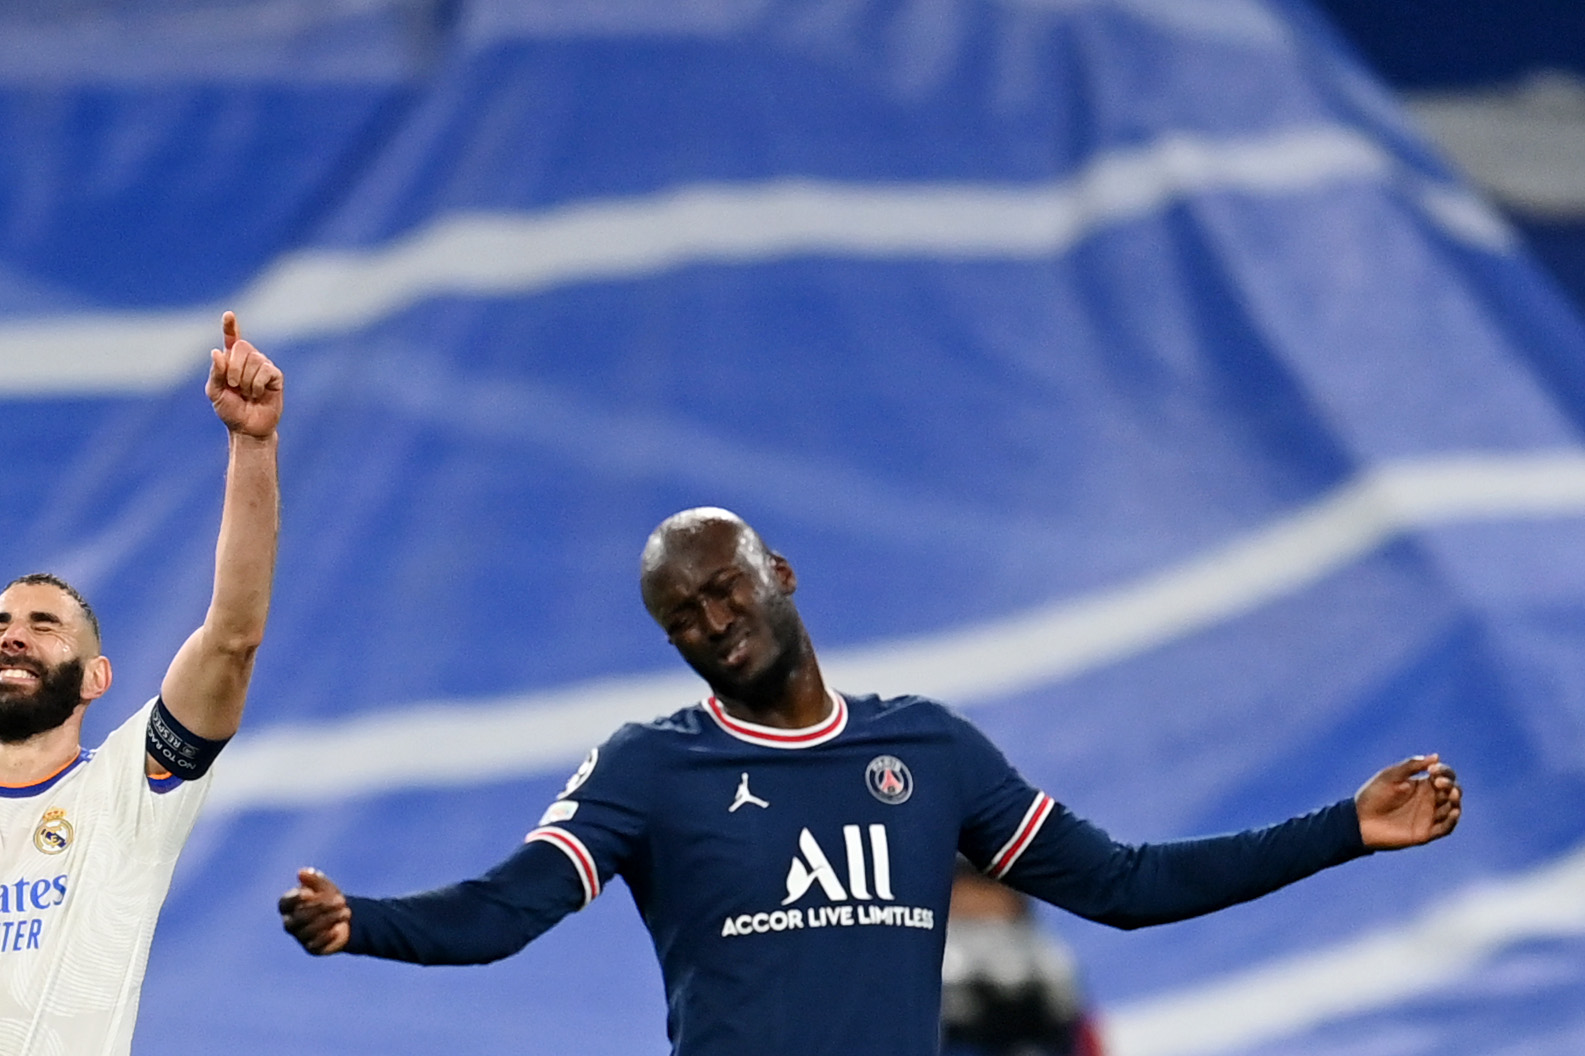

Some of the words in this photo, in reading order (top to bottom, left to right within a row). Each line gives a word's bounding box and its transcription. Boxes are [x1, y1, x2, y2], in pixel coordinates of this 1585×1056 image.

[162, 748, 176, 762] TO
[177, 759, 196, 770] NO
[721, 909, 804, 937] ACCOR
[807, 905, 854, 928] LIVE
[857, 905, 935, 930] LIMITLESS
